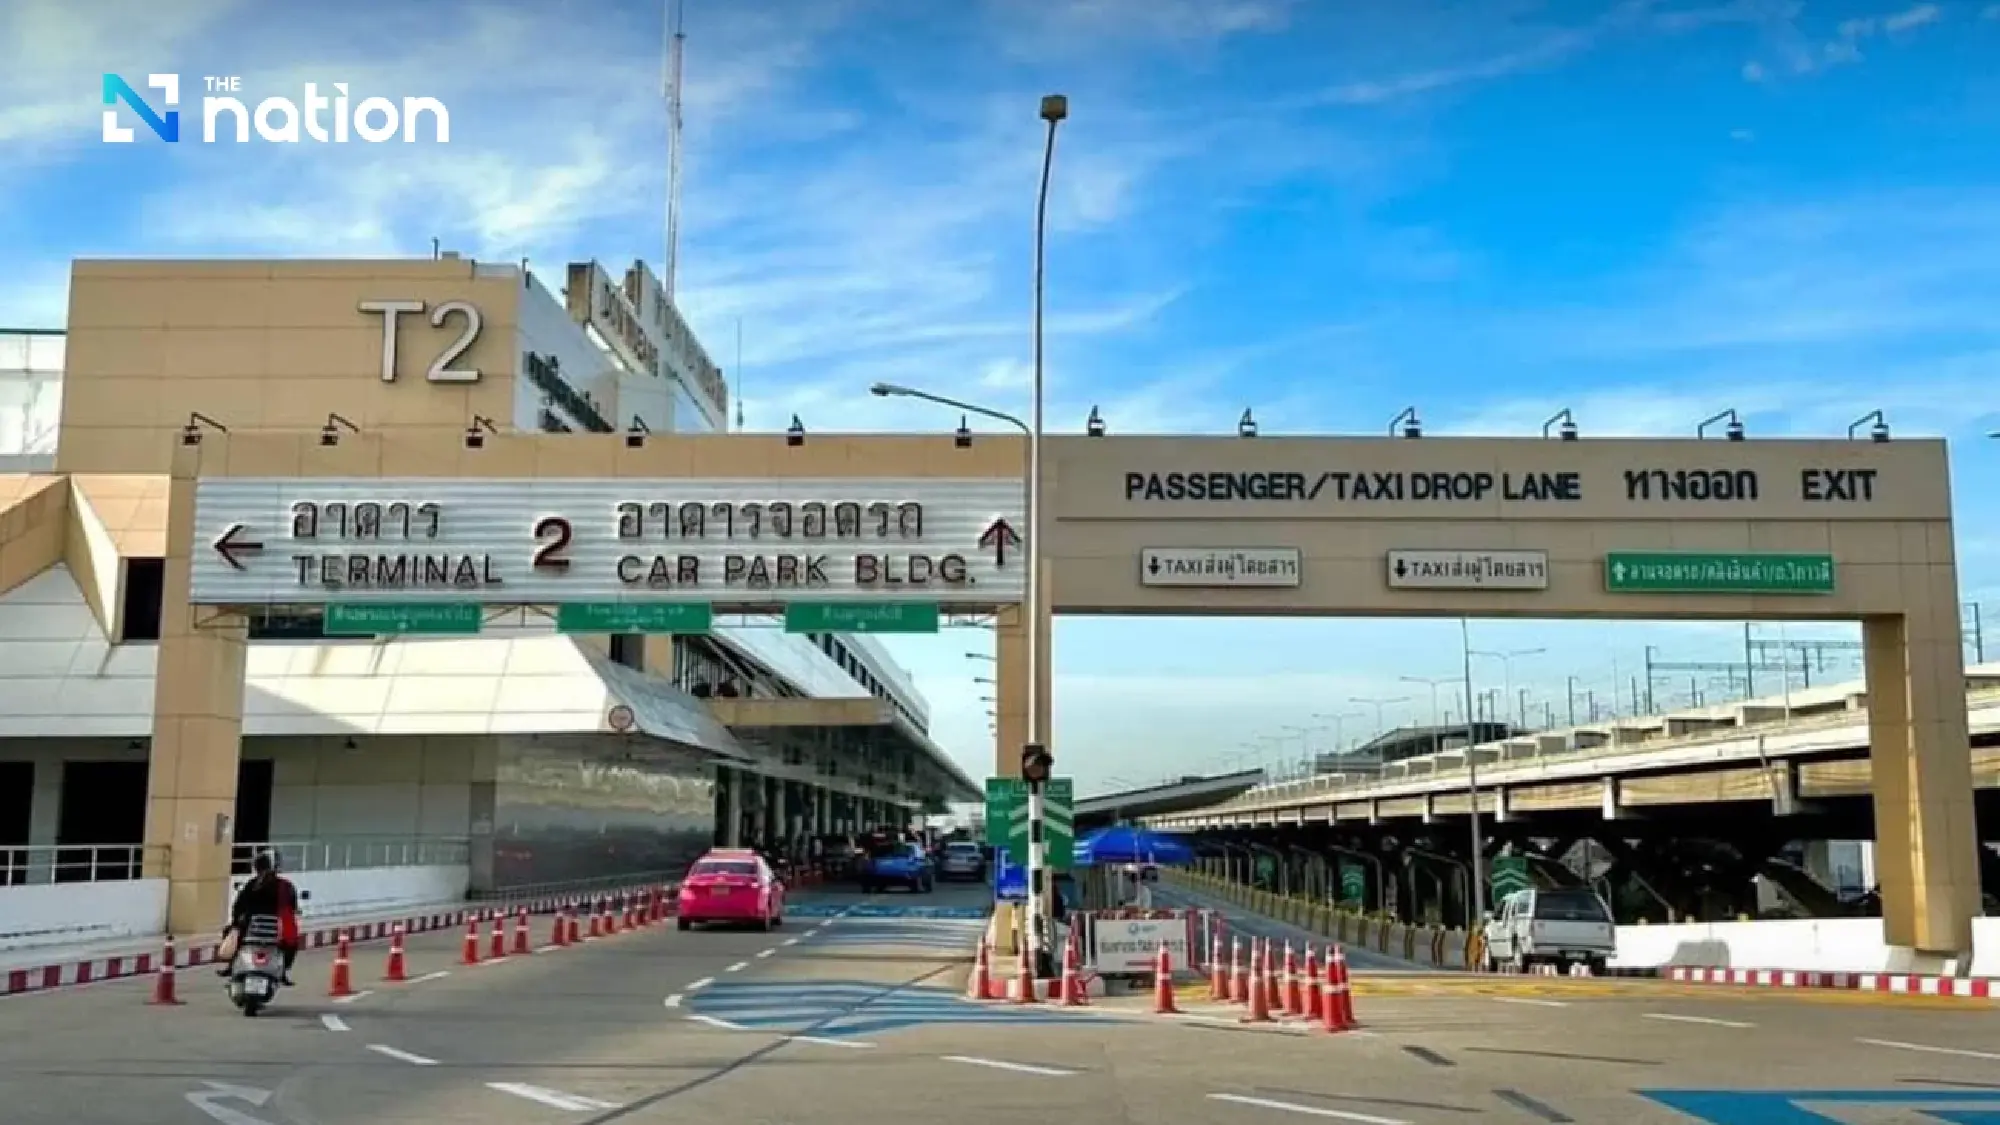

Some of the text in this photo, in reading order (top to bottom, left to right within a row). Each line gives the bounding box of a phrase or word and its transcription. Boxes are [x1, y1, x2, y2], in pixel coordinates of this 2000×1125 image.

[357, 300, 484, 383] T2
[1125, 472, 1581, 501] PASSENGER/TAXI DROP LANE
[1624, 468, 1758, 501] ทางออก
[1801, 468, 1877, 501] EXIT
[291, 501, 441, 540] อาคาร
[617, 501, 923, 540] อาคารจอดรถ
[533, 515, 572, 568] 2
[291, 554, 503, 587] TERMINAL
[616, 553, 977, 587] CAR PARK BLDG.
